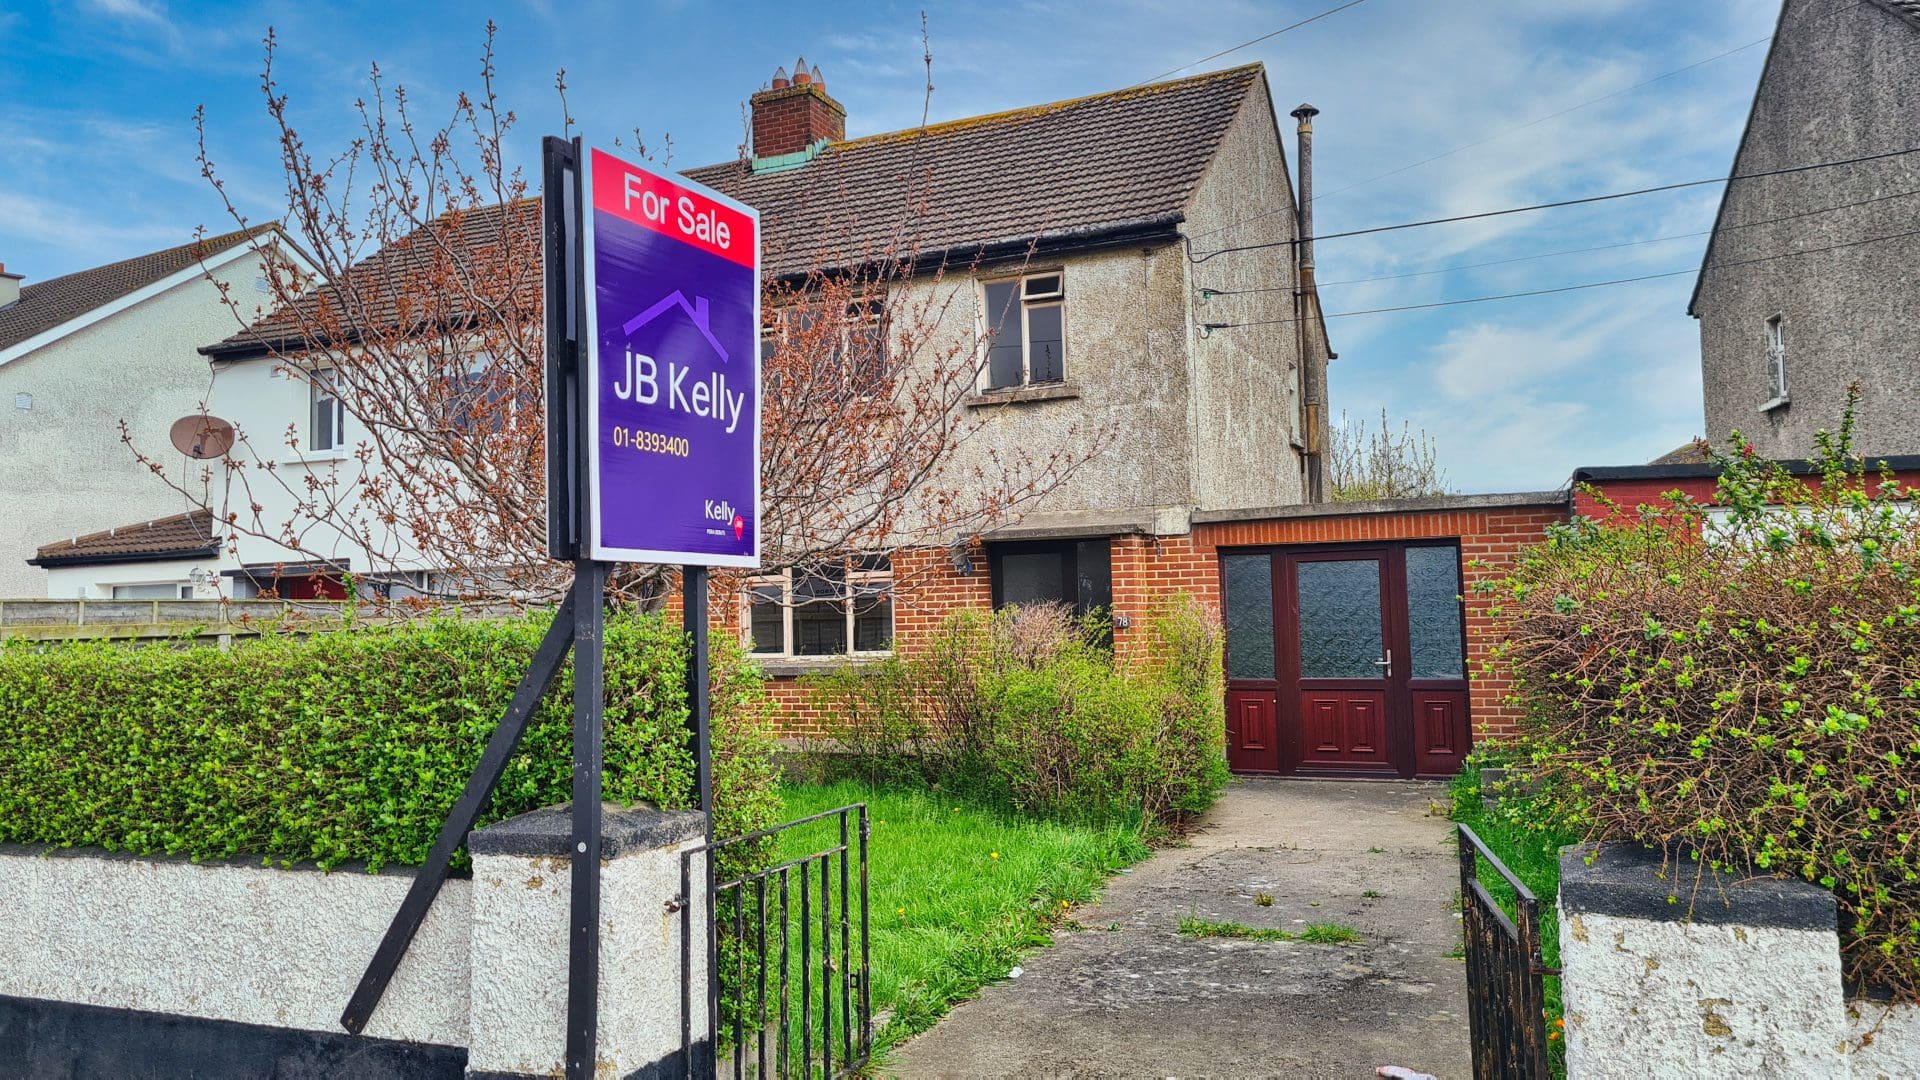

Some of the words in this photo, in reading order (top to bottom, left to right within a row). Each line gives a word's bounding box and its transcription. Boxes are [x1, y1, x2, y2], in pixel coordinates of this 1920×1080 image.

[624, 172, 670, 225] For
[677, 196, 731, 249] Sale
[614, 350, 659, 405] JB
[669, 362, 745, 434] Kelly
[613, 425, 689, 458] 01-8393400
[705, 499, 736, 526] Kelly
[1117, 616, 1128, 627] 78
